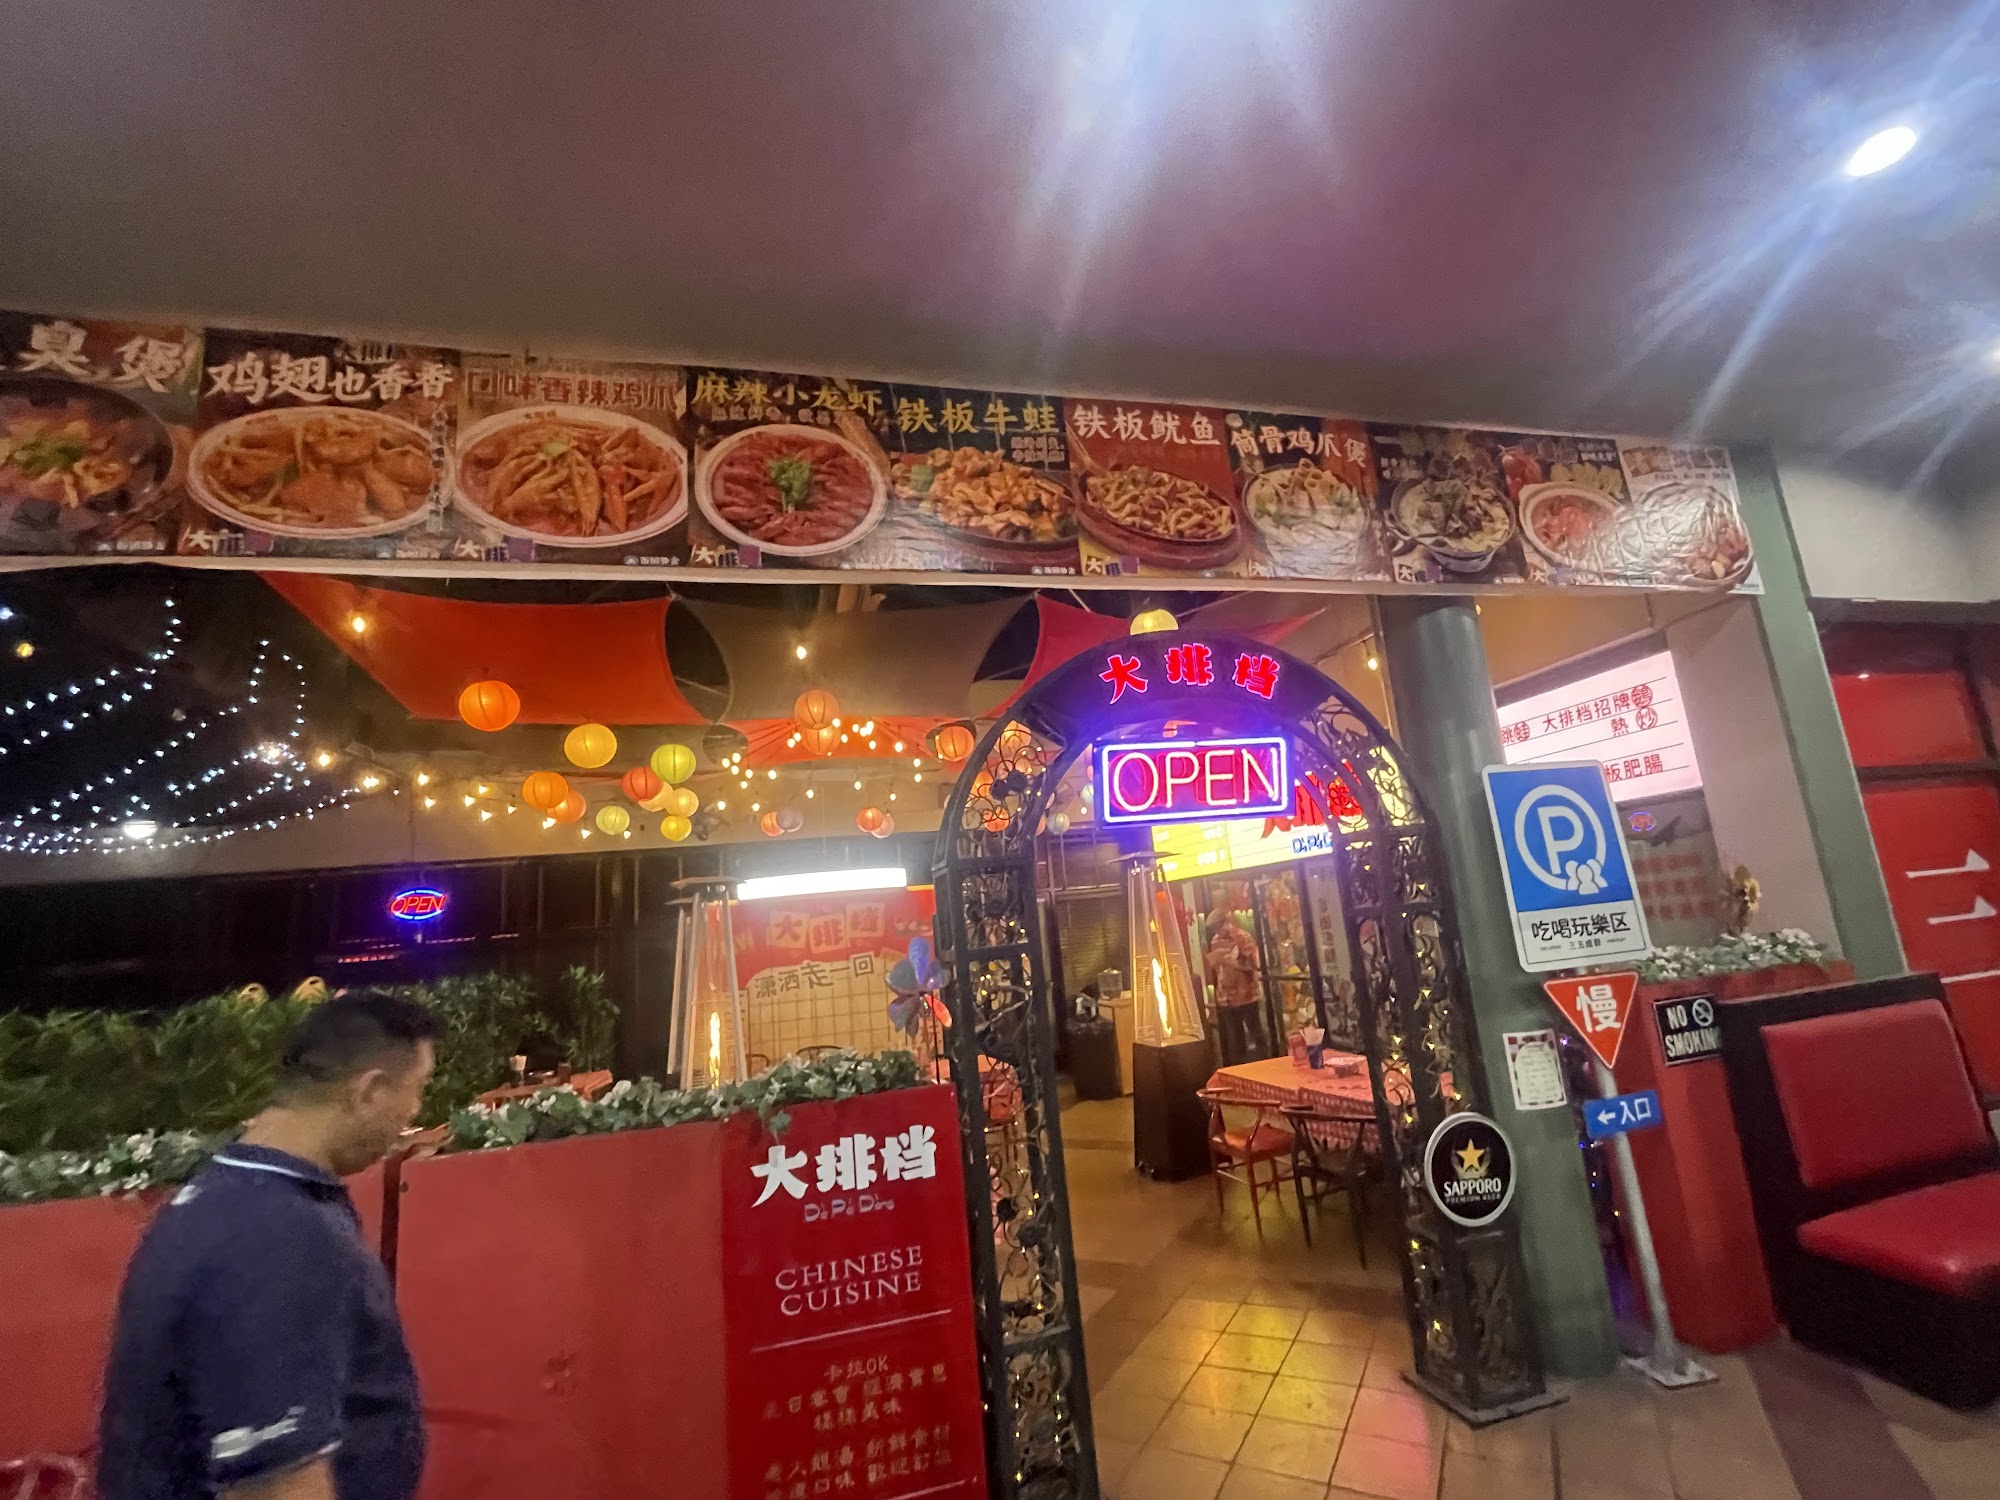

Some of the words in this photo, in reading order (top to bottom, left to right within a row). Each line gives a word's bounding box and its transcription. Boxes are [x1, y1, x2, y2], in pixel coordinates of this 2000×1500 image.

[692, 371, 883, 417] 麻辣小龙虾
[896, 397, 1060, 436] 铁板牛蛙
[1072, 404, 1221, 446] 铁板鱿鱼
[1099, 643, 1281, 704] 大排档
[1112, 746, 1281, 813] OPEN
[390, 894, 447, 914] OPEN
[775, 906, 879, 947] 大排档
[1531, 912, 1631, 941] 吃喝玩樂区
[754, 953, 874, 999] 潇洒走一回
[1576, 984, 1622, 1033] 慢
[1667, 1005, 1688, 1030] NO
[1665, 1028, 1721, 1057] SMOKIN
[1620, 1098, 1652, 1125] 入口
[750, 1124, 937, 1208] 大排档
[1443, 1177, 1502, 1197] SAPPORO
[775, 1245, 923, 1291] CHINESE
[780, 1271, 922, 1316] CUISINE
